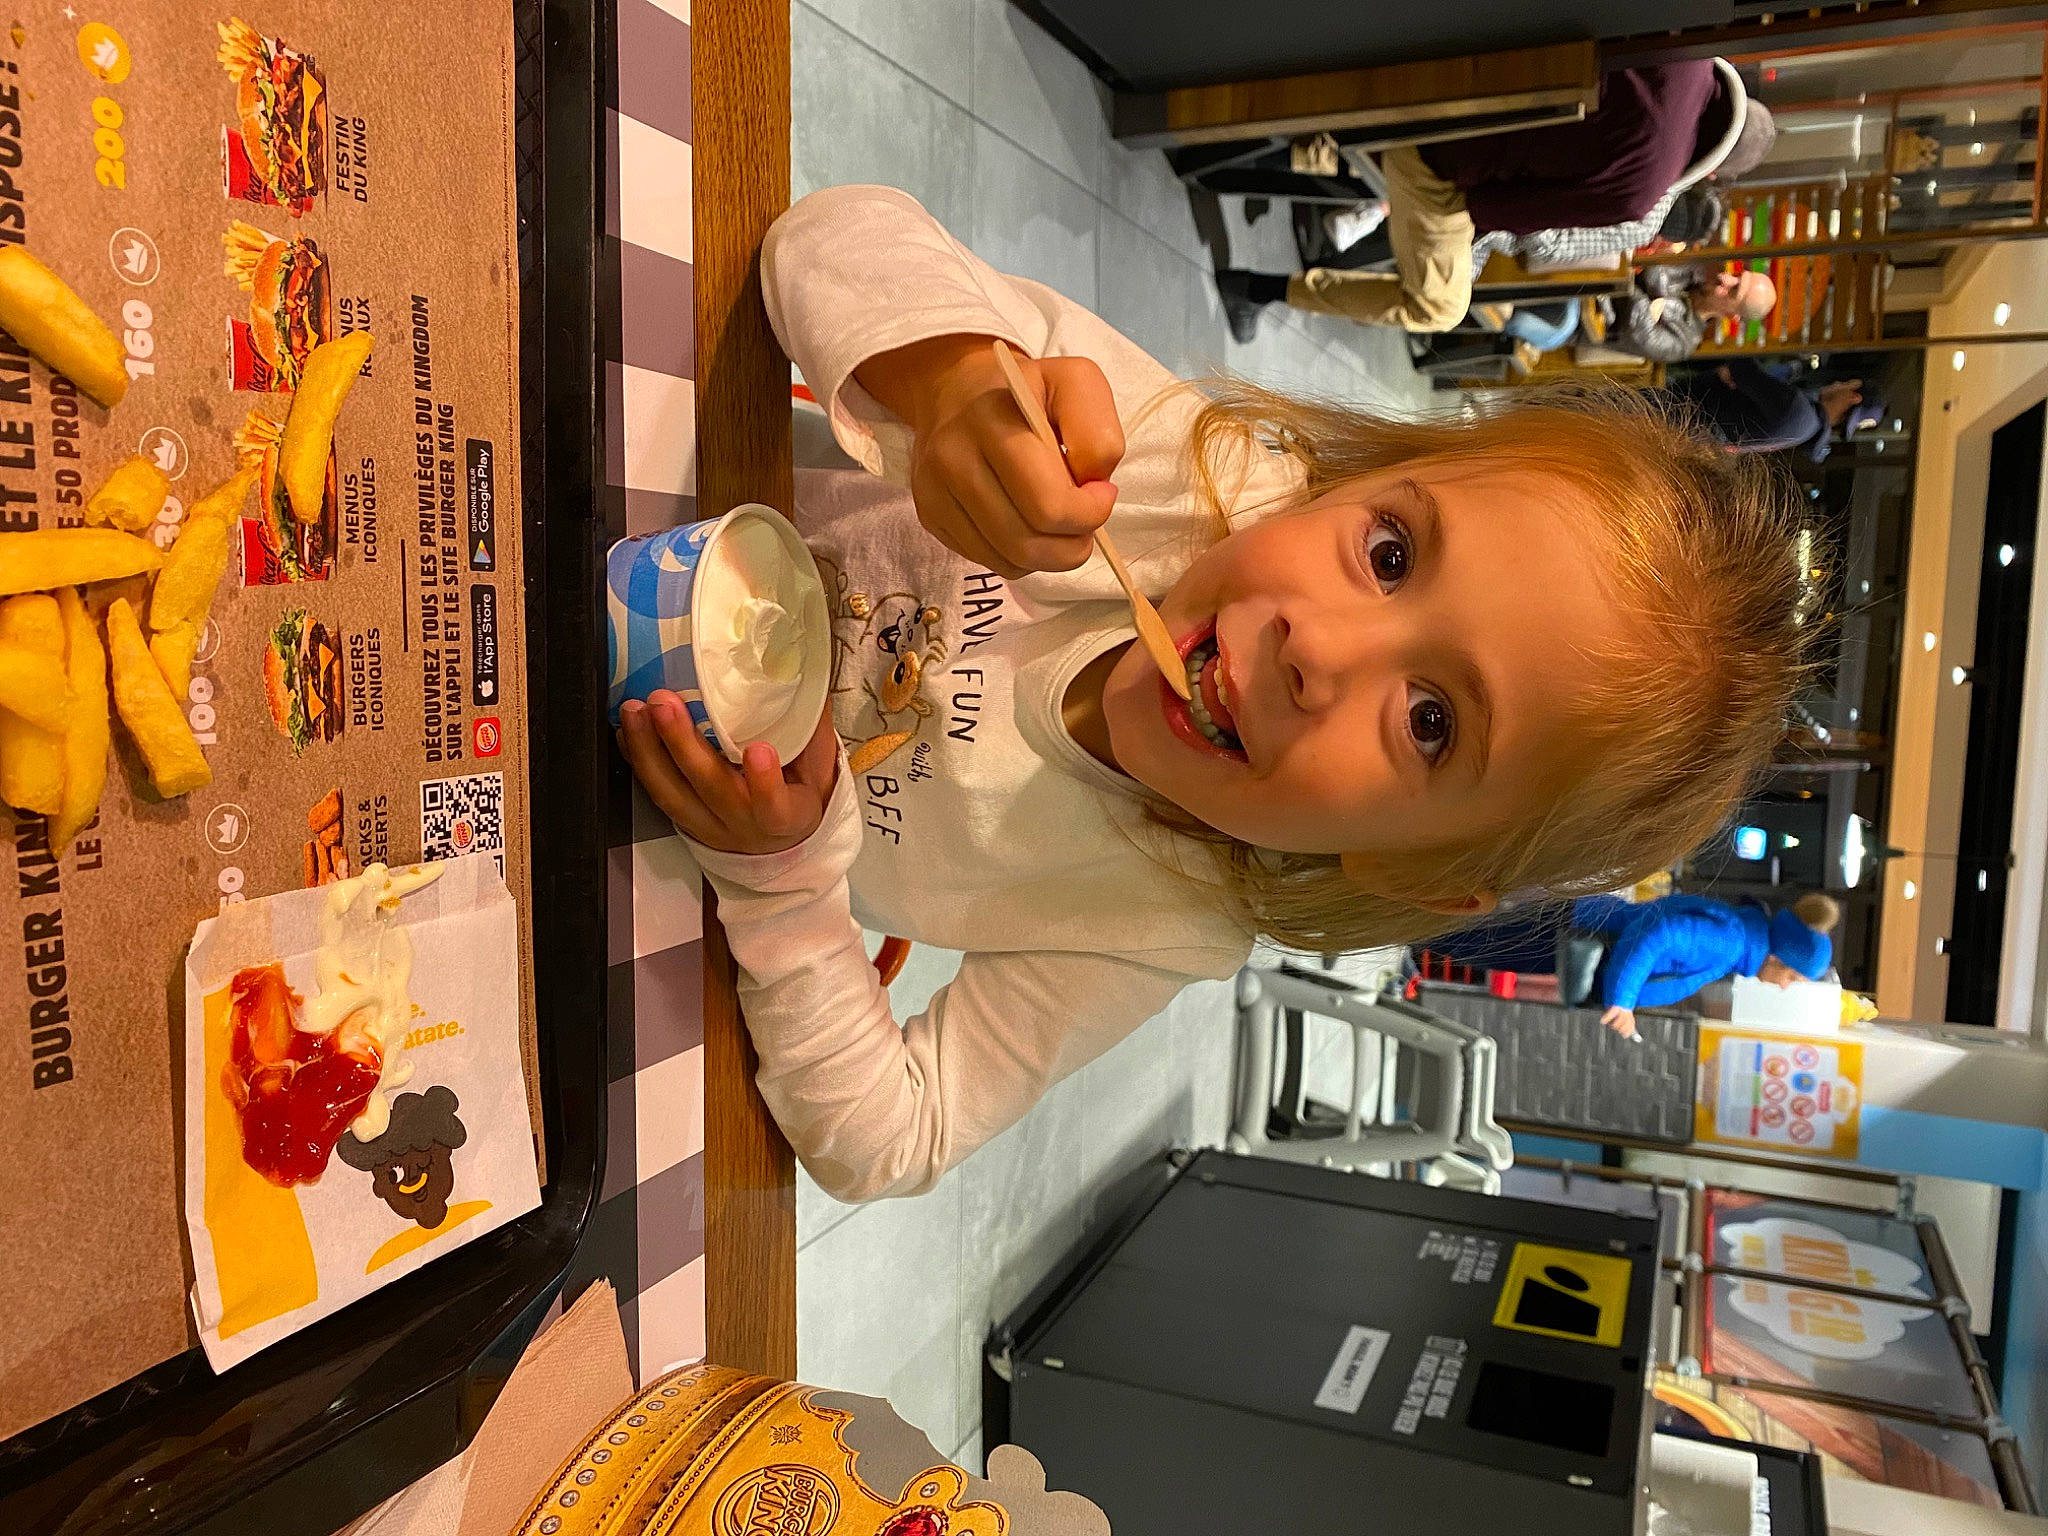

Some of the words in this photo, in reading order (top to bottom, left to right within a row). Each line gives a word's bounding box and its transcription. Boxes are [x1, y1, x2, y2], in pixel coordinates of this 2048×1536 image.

[92, 96, 126, 190] 200
[335, 115, 350, 192] FESTIN
[352, 116, 367, 169] KING
[353, 172, 368, 203] DU
[122, 299, 155, 381] 160
[339, 297, 354, 338] NUS
[411, 294, 432, 392] KINGDOM
[48, 365, 81, 459] PROD
[415, 396, 433, 426] DU
[437, 404, 455, 453] KING
[0, 420, 35, 470] LE
[477, 448, 490, 478] Play
[0, 486, 38, 533] ET
[55, 469, 82, 507] 50
[344, 474, 360, 544] MENUS
[361, 457, 377, 563] ICONIQUES
[413, 432, 436, 547] PRIVILÈGES
[439, 459, 457, 539] BURGER
[470, 486, 478, 532] DISPONIBLE
[478, 481, 491, 533] Google
[154, 495, 183, 549] 30
[420, 554, 437, 587] LES
[441, 545, 458, 586] SITE
[421, 593, 439, 643] TOUS
[443, 592, 460, 614] LE
[482, 593, 492, 633] Store
[444, 620, 460, 642] ET
[349, 634, 368, 726] BURGERS
[367, 627, 385, 731] ICONIQUES
[188, 676, 216, 745] 100
[421, 648, 442, 763] DÉCOUVREZ
[947, 669, 984, 743] FUN
[446, 722, 462, 761] SUR
[906, 741, 933, 783] with
[358, 799, 372, 812] &
[374, 795, 388, 866] SSERTS
[76, 838, 102, 871] LE
[358, 817, 374, 867] ACKS
[460, 822, 468, 845] KING
[22, 908, 73, 1090] BURGER
